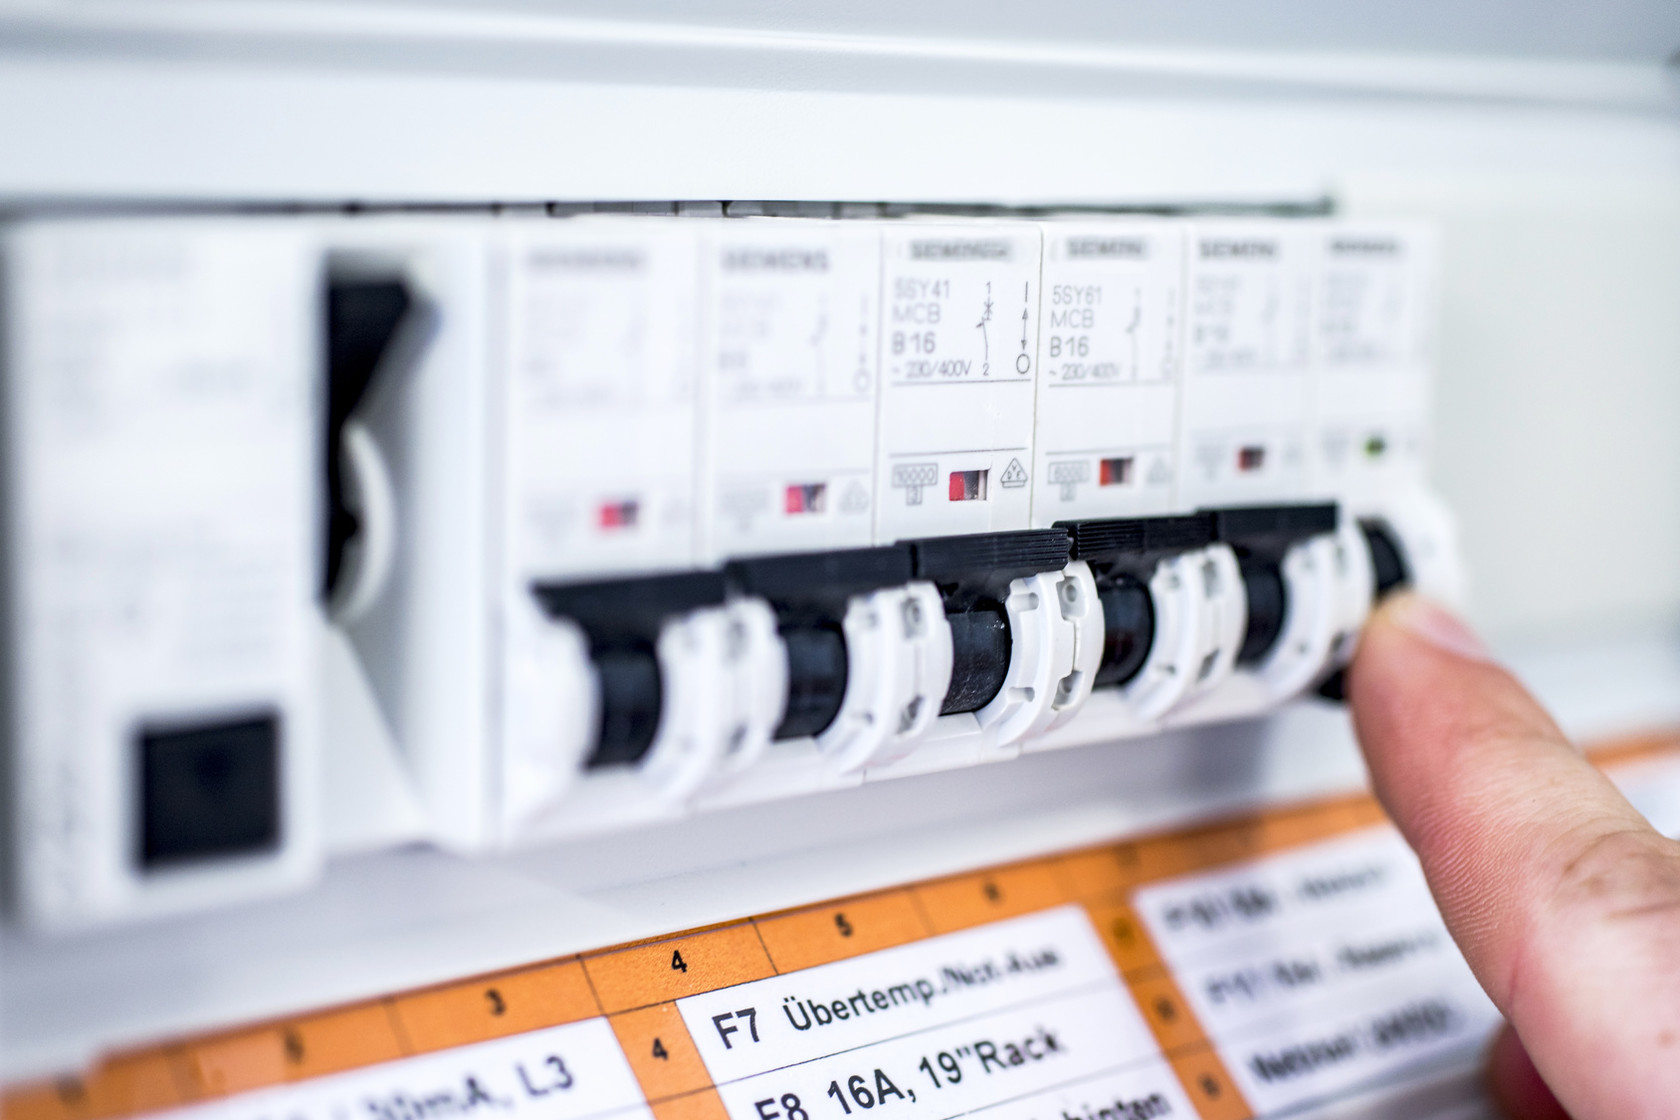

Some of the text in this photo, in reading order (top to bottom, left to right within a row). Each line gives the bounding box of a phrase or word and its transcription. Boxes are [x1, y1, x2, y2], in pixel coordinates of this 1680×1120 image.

[893, 302, 941, 325] MCB
[1050, 308, 1095, 329] MCB
[833, 913, 853, 938] 5
[670, 949, 688, 974] 4
[485, 989, 506, 1017] 3
[712, 1007, 758, 1050] F7
[650, 1038, 669, 1062] 4
[515, 1055, 574, 1097] L3
[827, 1068, 917, 1115] 16A,
